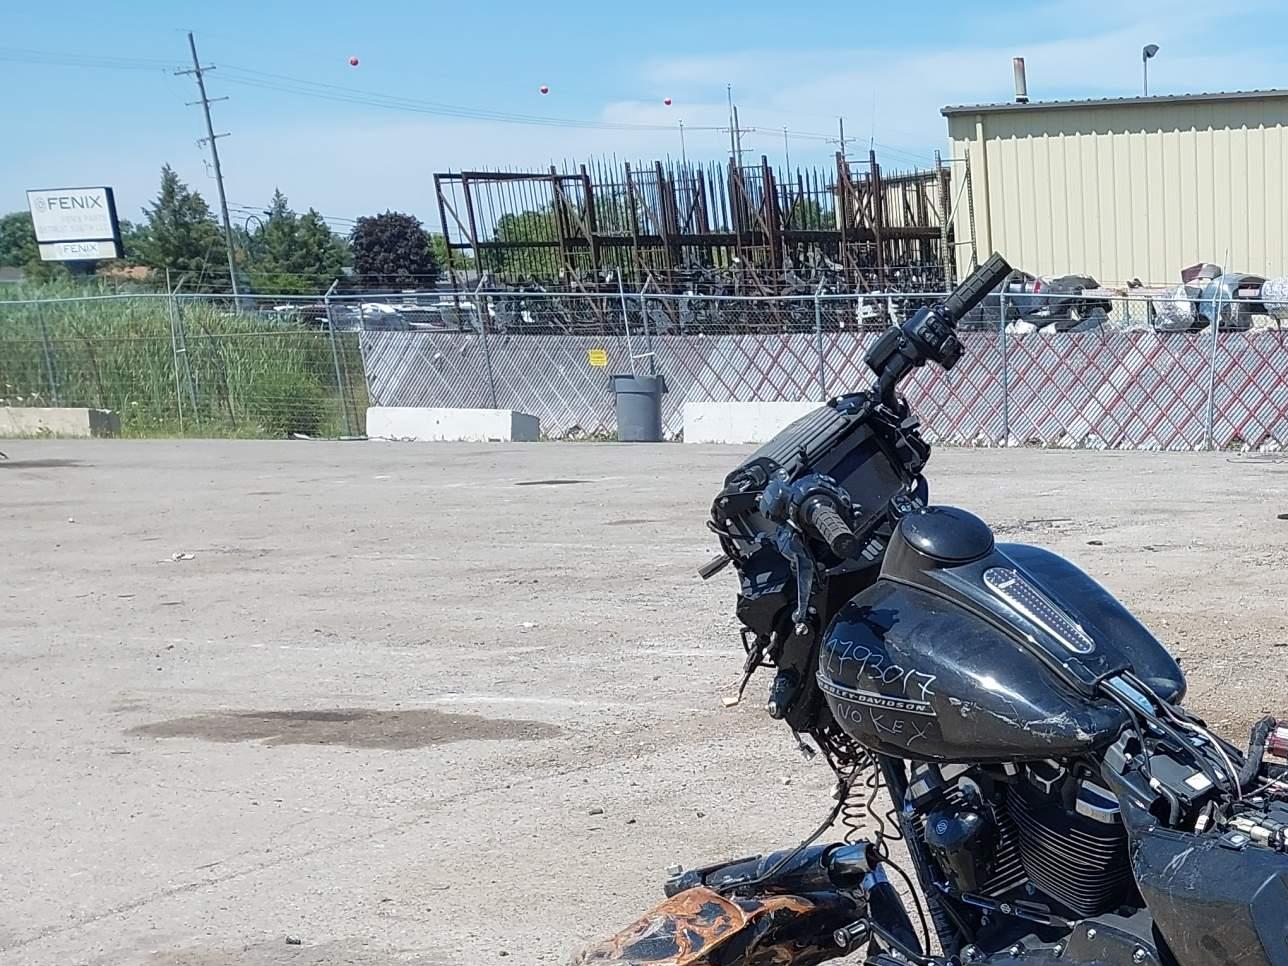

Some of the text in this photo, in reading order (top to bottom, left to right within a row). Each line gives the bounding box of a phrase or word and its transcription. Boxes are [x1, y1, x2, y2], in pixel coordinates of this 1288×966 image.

[47, 195, 103, 210] FENIX
[63, 244, 97, 253] FENIX
[837, 703, 934, 747] NO KEY
